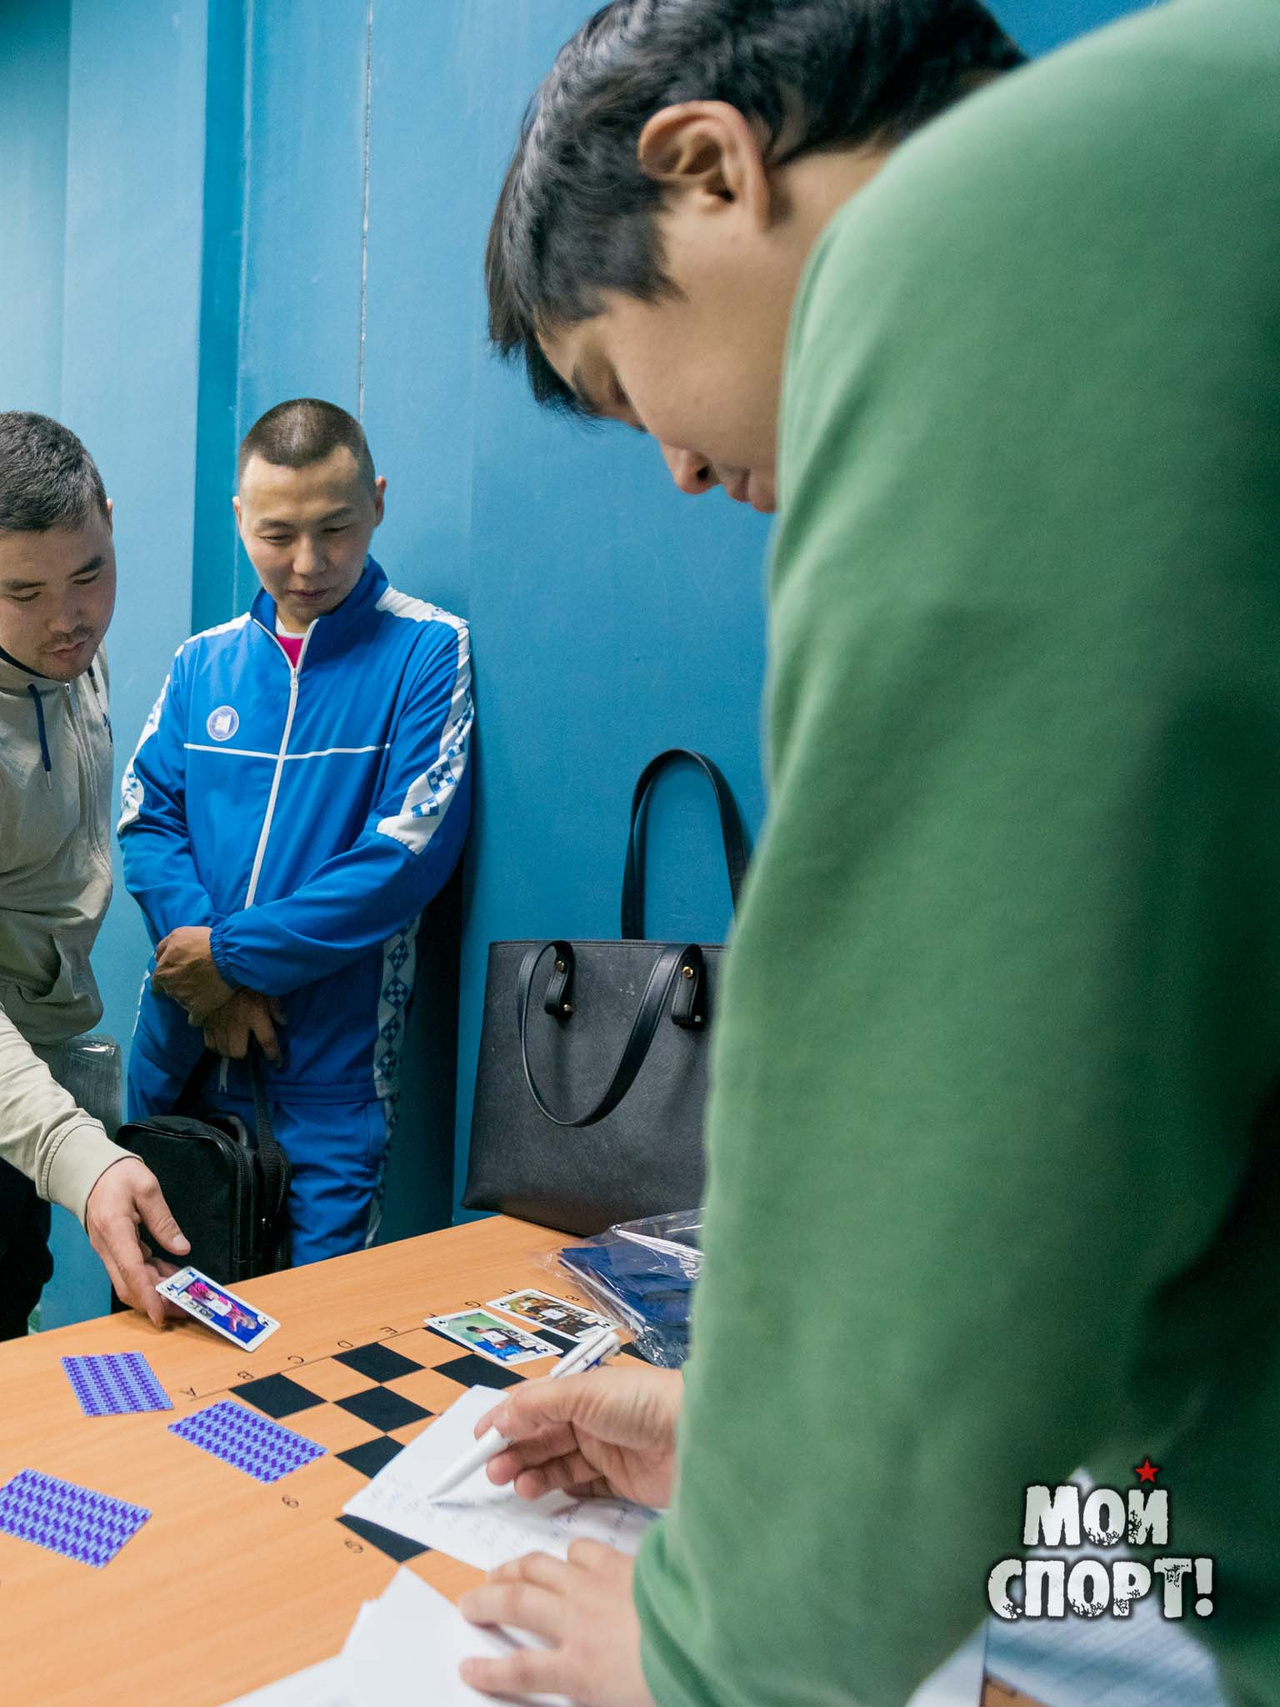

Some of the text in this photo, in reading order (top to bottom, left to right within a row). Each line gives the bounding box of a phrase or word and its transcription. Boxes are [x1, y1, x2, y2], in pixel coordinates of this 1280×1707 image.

[180, 1387, 197, 1397] A
[237, 1370, 255, 1380] B
[286, 1355, 304, 1364] C
[337, 1340, 354, 1349] D
[380, 1326, 398, 1335] E
[464, 1300, 481, 1309] G
